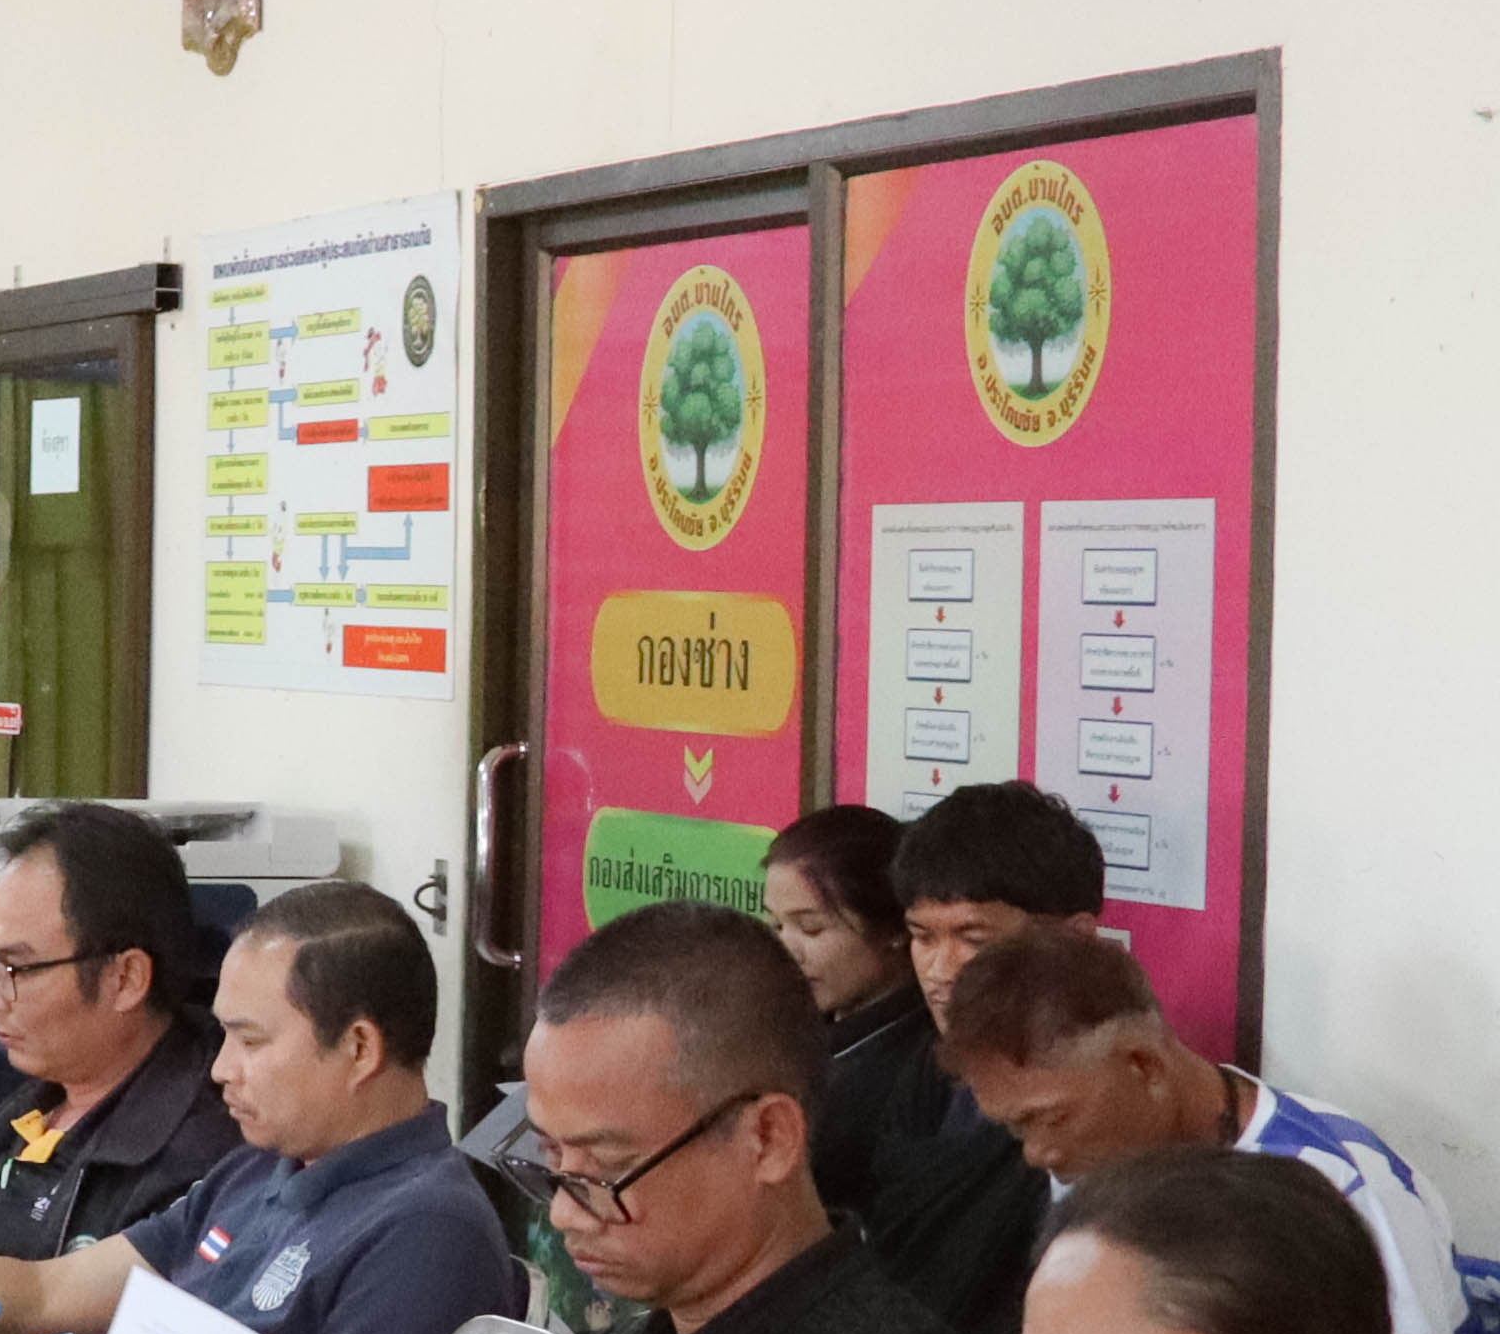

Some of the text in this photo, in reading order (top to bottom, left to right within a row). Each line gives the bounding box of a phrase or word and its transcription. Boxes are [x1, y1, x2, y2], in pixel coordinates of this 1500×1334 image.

[990, 166, 1086, 237] อบต.บ้านไทร
[660, 268, 745, 339] อบต.บ้านไทร
[637, 611, 750, 691] กองช่าง
